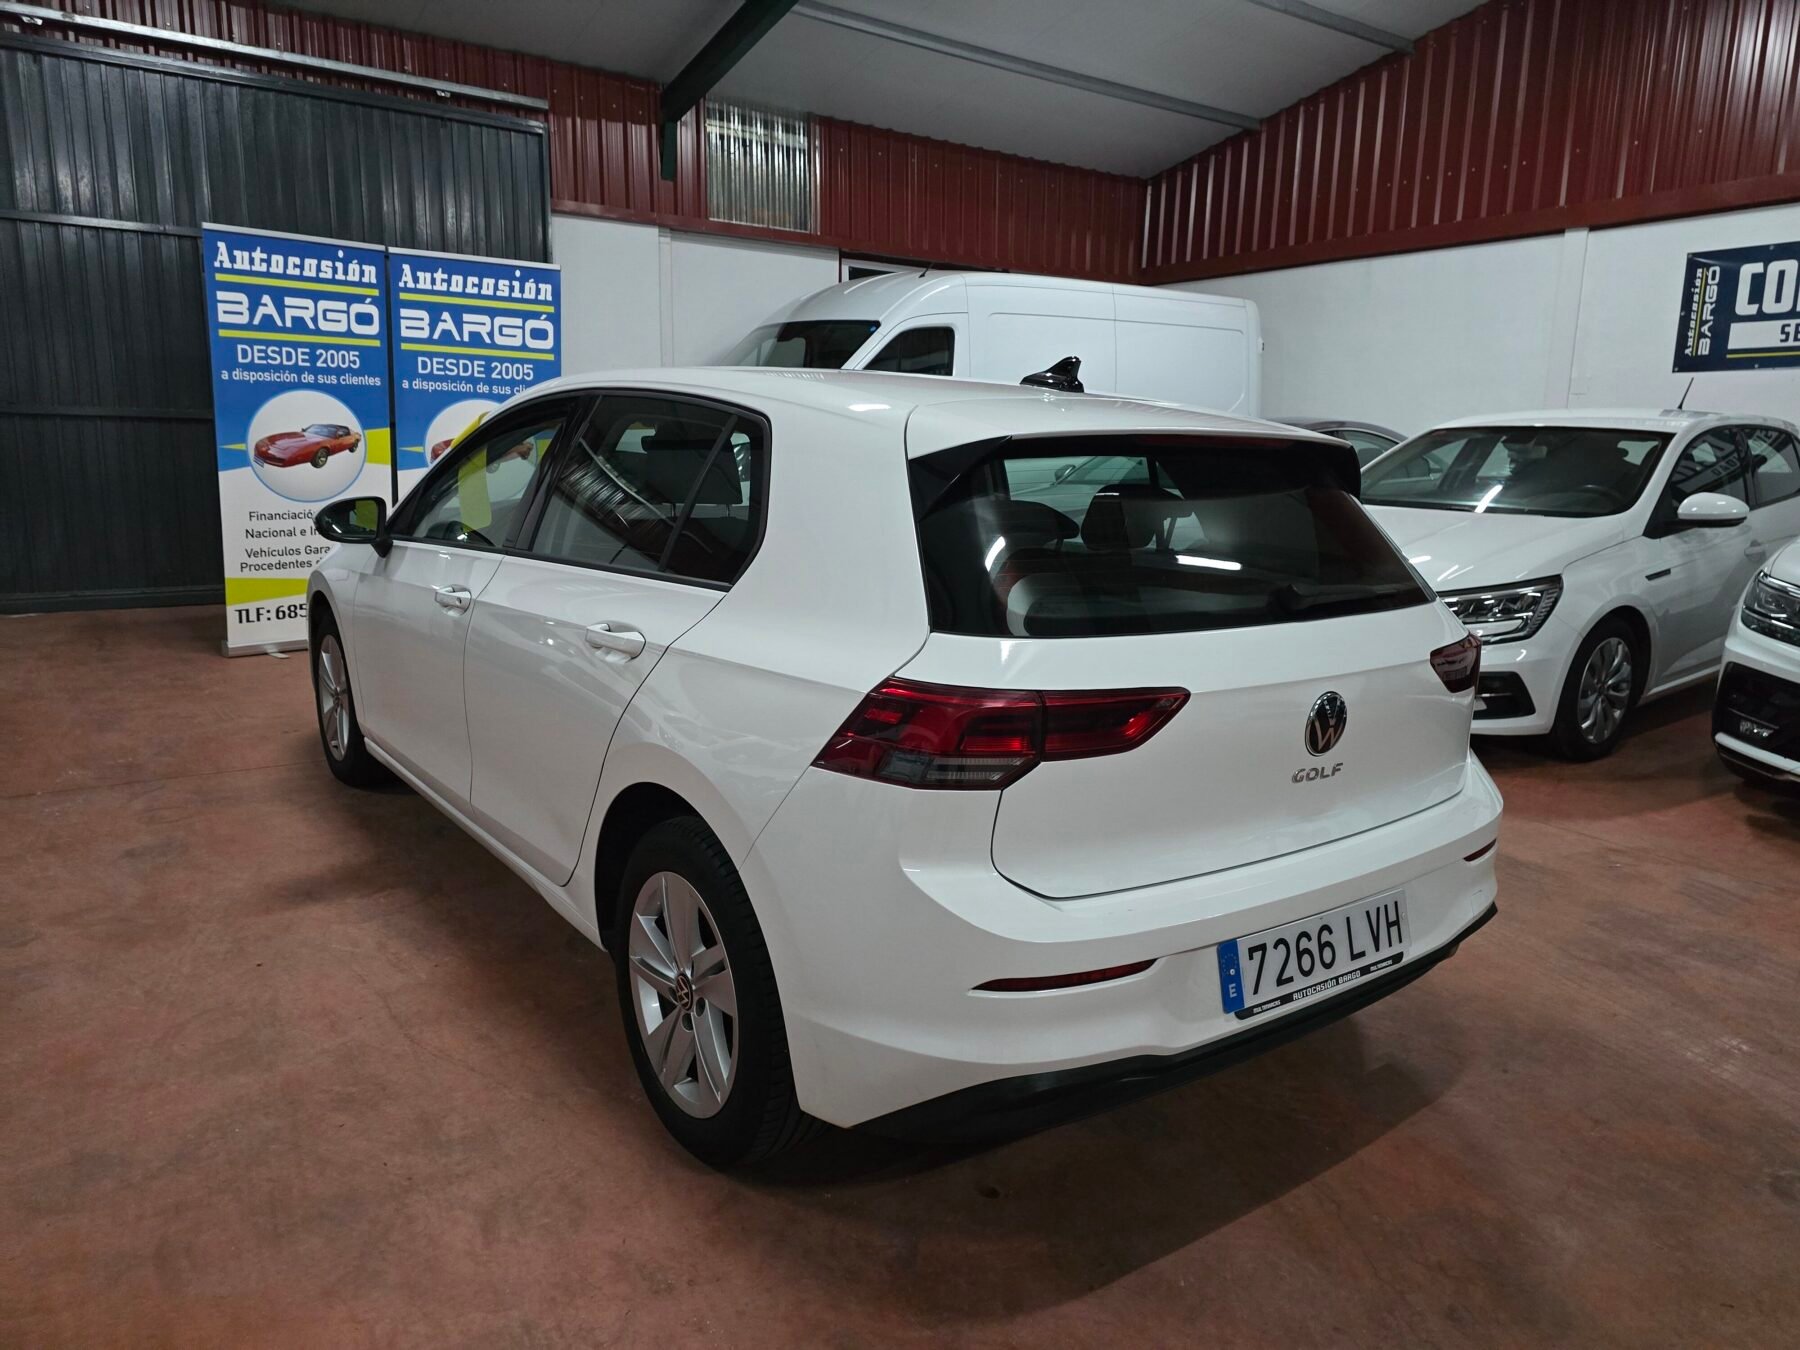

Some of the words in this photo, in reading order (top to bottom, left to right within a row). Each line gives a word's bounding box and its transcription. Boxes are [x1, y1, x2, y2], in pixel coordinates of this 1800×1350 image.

[214, 241, 377, 284] Autocasión
[398, 263, 553, 301] Autocasión
[216, 290, 380, 336] BARGÓ
[400, 308, 554, 350] BARGÓ
[237, 344, 311, 367] DESDE
[316, 349, 361, 370] 2005
[221, 370, 229, 380] a
[232, 368, 298, 384] disposición
[301, 371, 315, 384] de
[317, 373, 338, 385] sus
[340, 373, 382, 387] clientes
[417, 356, 486, 378] DESDE
[491, 362, 534, 381] 2005
[402, 379, 409, 389] a
[412, 378, 474, 393] disposición
[476, 381, 490, 394] de
[492, 384, 511, 395] sus
[248, 509, 315, 522] Financiació
[245, 526, 297, 540] Nacional
[300, 528, 307, 537] e
[245, 546, 302, 559] Vehículos
[240, 559, 313, 573] Procedentes
[234, 606, 271, 624] TLF:
[275, 603, 308, 620] 685
[1291, 762, 1344, 784] GOLF
[1247, 923, 1336, 996] 7266
[1346, 901, 1403, 962] LVH
[1228, 983, 1237, 998] E
